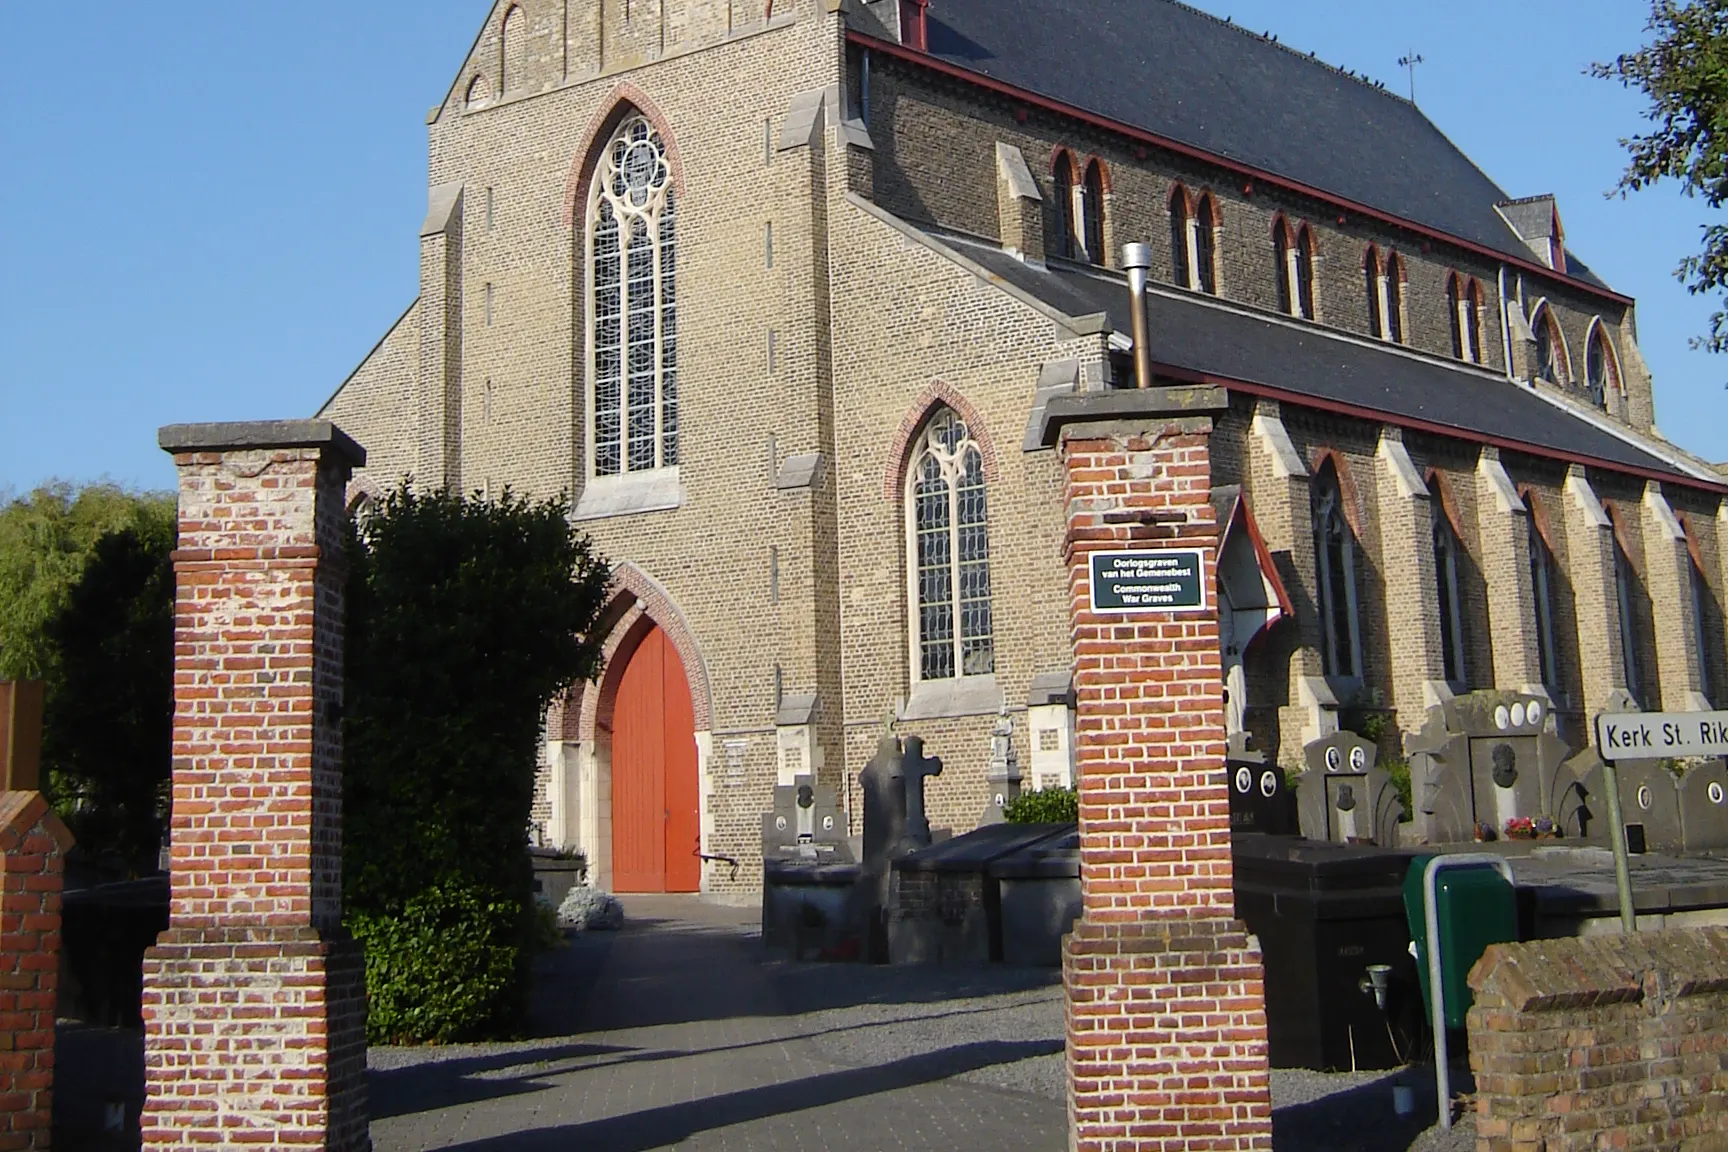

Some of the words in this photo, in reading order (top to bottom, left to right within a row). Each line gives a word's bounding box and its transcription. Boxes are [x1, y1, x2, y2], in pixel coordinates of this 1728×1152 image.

[1113, 558, 1178, 568] Oorlogsgraven
[1102, 571, 1118, 579] van
[1120, 569, 1135, 578] het
[1136, 568, 1191, 578] Gemenebest
[1113, 583, 1181, 593] Commonwealth
[1122, 594, 1140, 603] War
[1141, 594, 1173, 603] Graves
[1606, 724, 1652, 748] Kerk
[1663, 722, 1690, 746] St.
